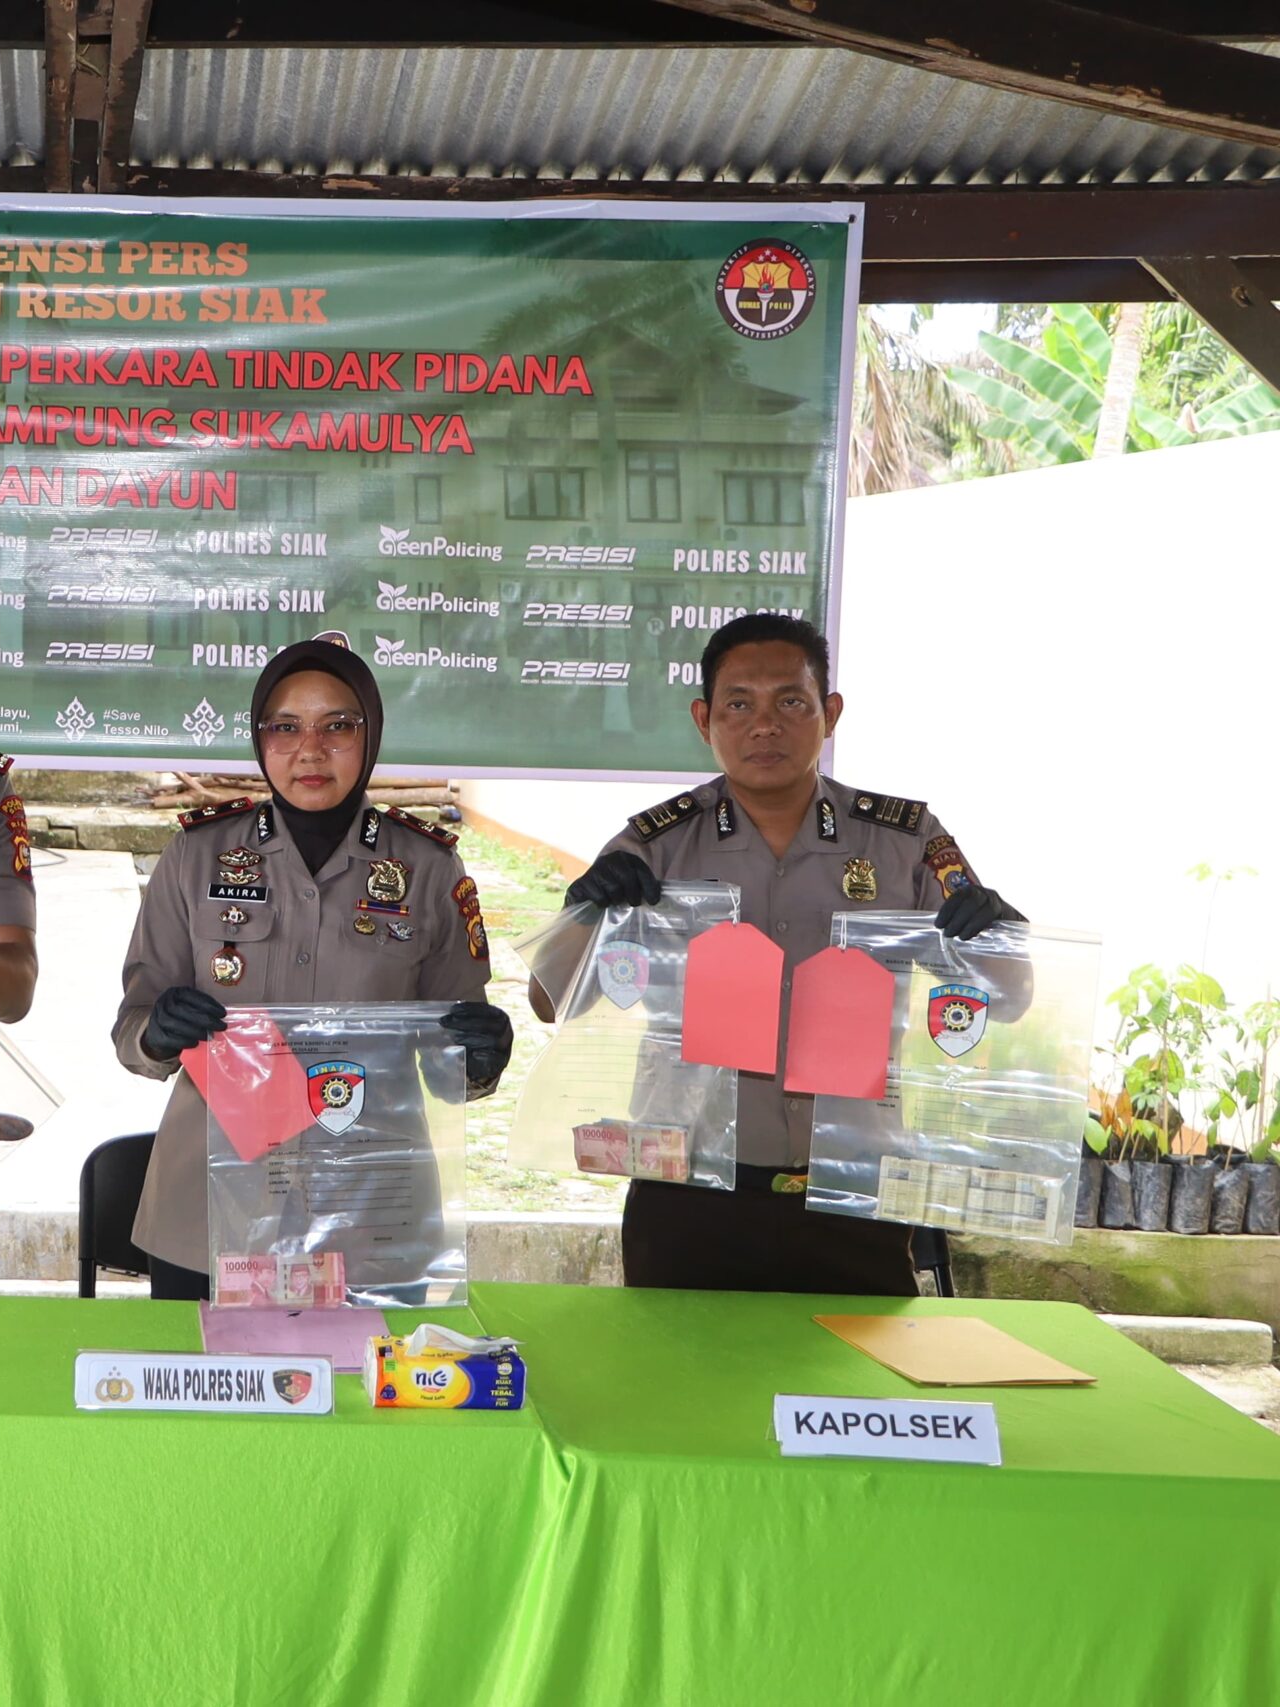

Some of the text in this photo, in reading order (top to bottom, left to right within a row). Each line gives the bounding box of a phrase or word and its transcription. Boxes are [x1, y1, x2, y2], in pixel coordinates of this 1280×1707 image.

[118, 241, 249, 276] PERS
[17, 281, 187, 321] RESOR
[198, 287, 328, 324] SIAK
[733, 322, 794, 339] PARTISIPASI
[0, 345, 218, 388] PERKARA
[227, 350, 404, 392] TINDAK
[414, 352, 593, 396] PIDANA
[188, 409, 475, 455] SUKAMULYA
[76, 469, 237, 511] DAYUN
[48, 527, 159, 547] PRESISI
[195, 530, 328, 556] POLRES SIAK
[525, 545, 637, 563] PRESISI
[673, 549, 807, 575] POLRES SIAK
[47, 584, 158, 603] PRESISI
[194, 588, 325, 612] POLRES SIAK
[523, 603, 634, 621] PRESISI
[46, 642, 156, 660] PRESISI
[192, 643, 268, 667] POLRES
[521, 661, 631, 679] PRESISI
[103, 709, 141, 721] #Save
[103, 724, 169, 736] Tesso Nilo
[218, 887, 258, 898] AKIRA
[315, 1064, 362, 1076] INAFIS
[224, 1260, 258, 1272] 100000
[143, 1367, 266, 1402] WAKA POLRES SIAK
[794, 1411, 977, 1440] KAPOLSEK
